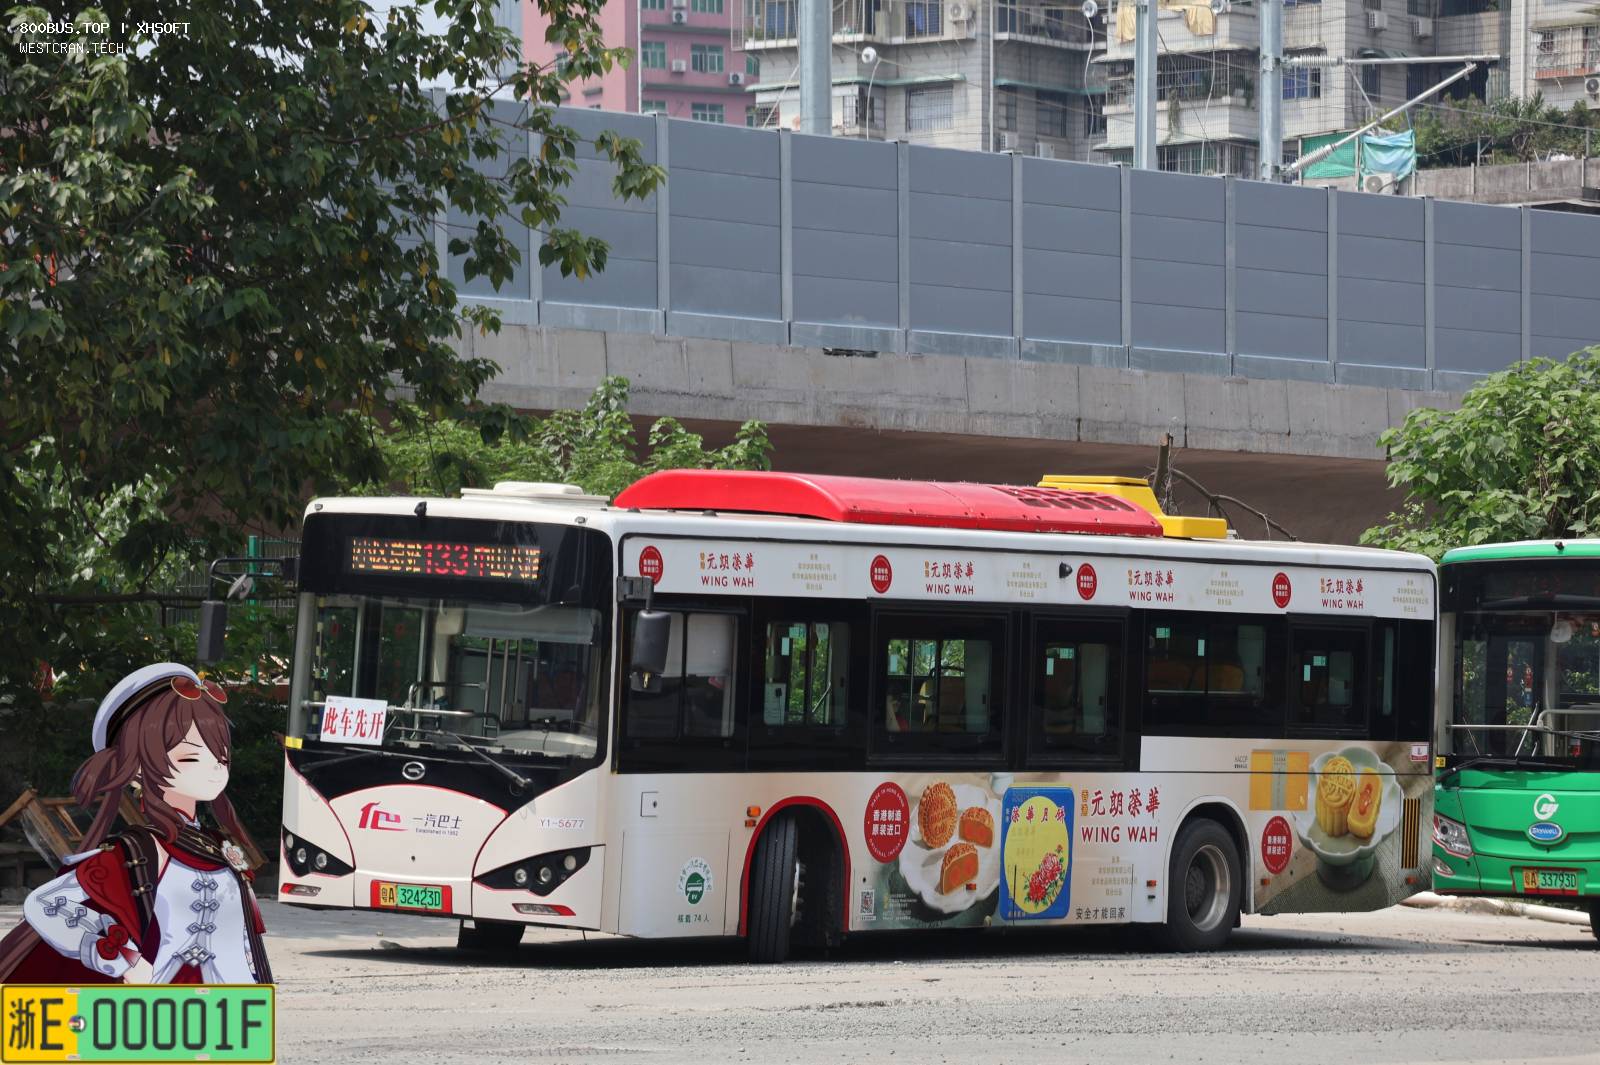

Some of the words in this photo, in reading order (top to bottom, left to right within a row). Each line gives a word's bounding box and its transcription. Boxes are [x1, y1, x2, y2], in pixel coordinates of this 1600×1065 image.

[423, 543, 469, 576] 133
[701, 575, 729, 588] WING
[732, 577, 754, 588] WAH
[925, 583, 950, 595] WING
[954, 584, 974, 595] WAH
[1129, 591, 1152, 602] WING
[1155, 592, 1174, 602] WAH
[1321, 598, 1343, 609] WING
[1346, 599, 1364, 609] WAH
[322, 706, 385, 740] 此车先开
[1091, 786, 1160, 819] 元朗榮華
[412, 813, 463, 830] 一汽巴士
[540, 818, 585, 829] Y1-5677
[1081, 826, 1120, 843] WING
[1127, 826, 1158, 843] WAH
[1541, 872, 1576, 888] 33793D
[400, 888, 441, 907] 32423D
[694, 914, 702, 922] 74
[1075, 906, 1126, 920] 安全才能回家
